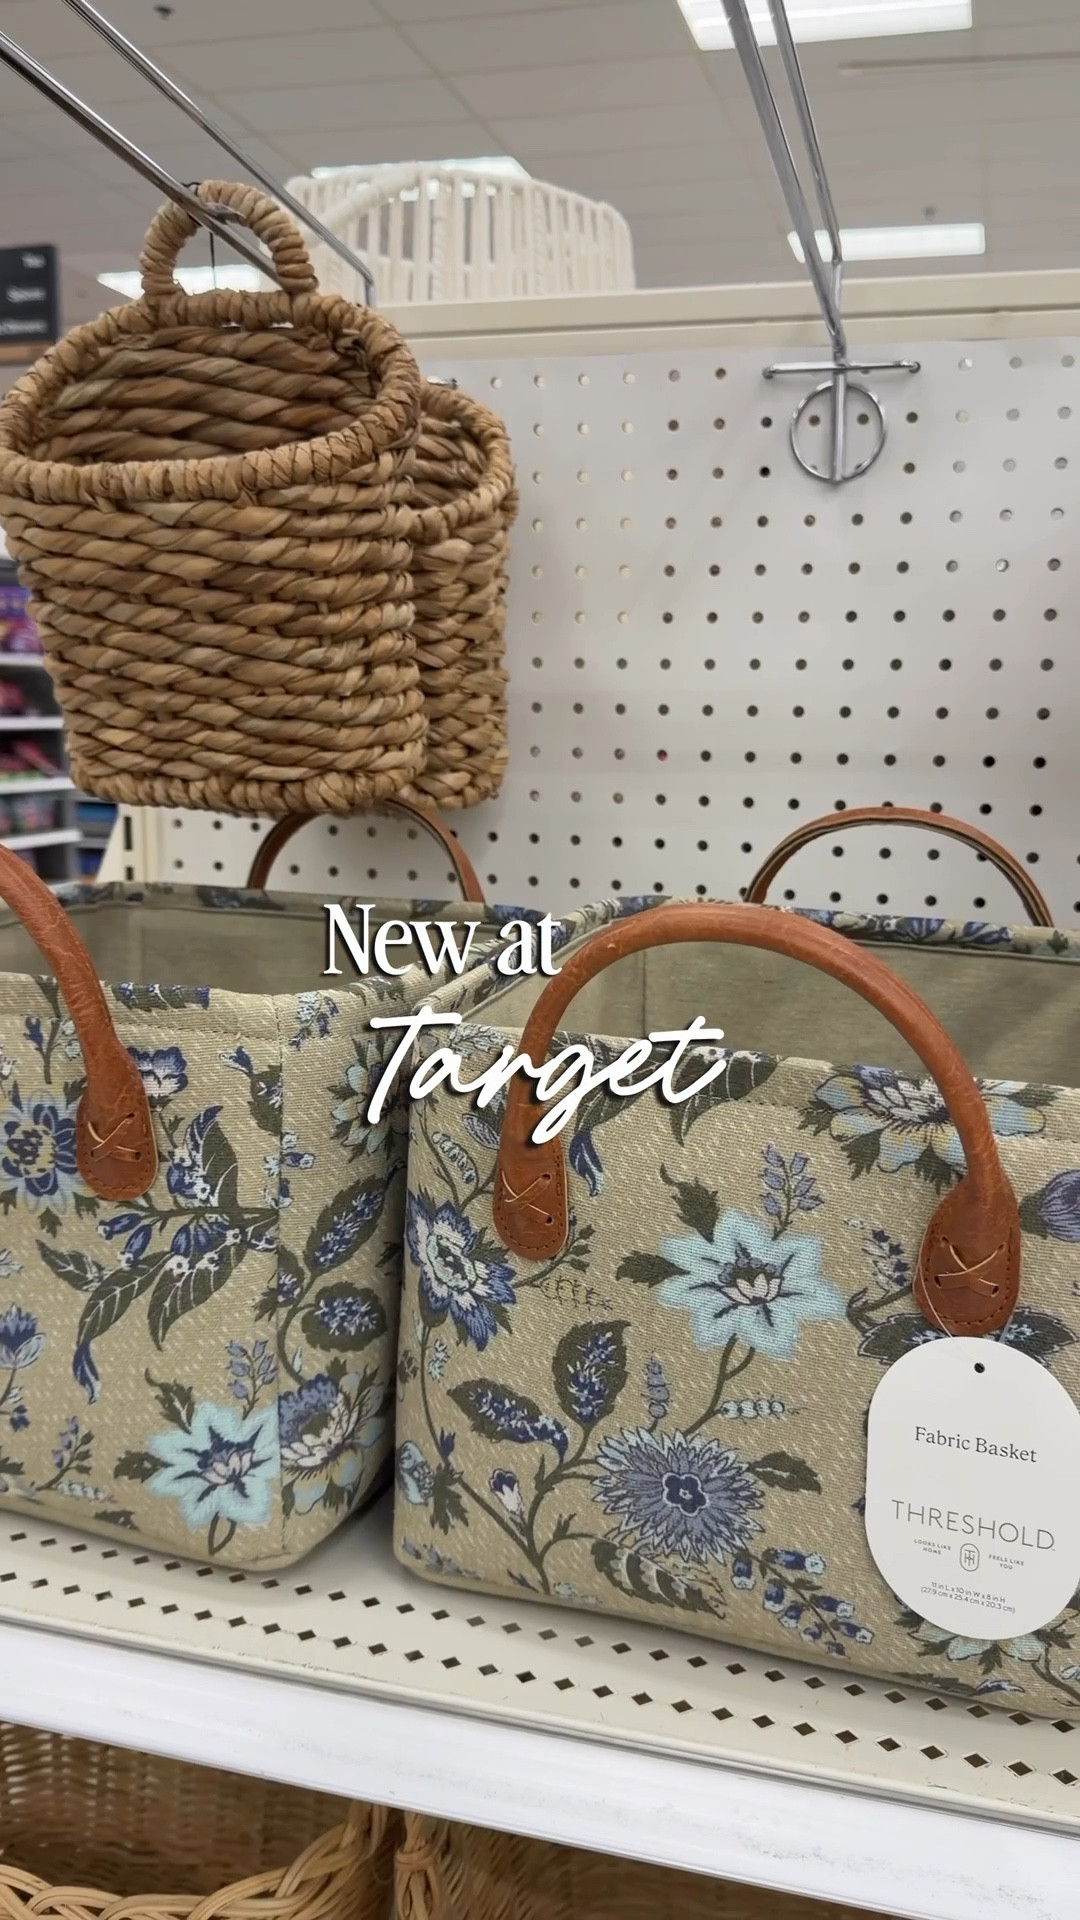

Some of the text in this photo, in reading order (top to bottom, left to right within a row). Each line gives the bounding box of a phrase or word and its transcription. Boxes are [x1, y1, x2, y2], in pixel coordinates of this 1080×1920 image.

[915, 1426, 1037, 1463] Fabric Basket
[891, 1499, 1055, 1550] THRESHOLD
[913, 1538, 952, 1551] LOOKS LIKE
[922, 1547, 942, 1555] HOME
[988, 1554, 1024, 1566] FEELS LIKE
